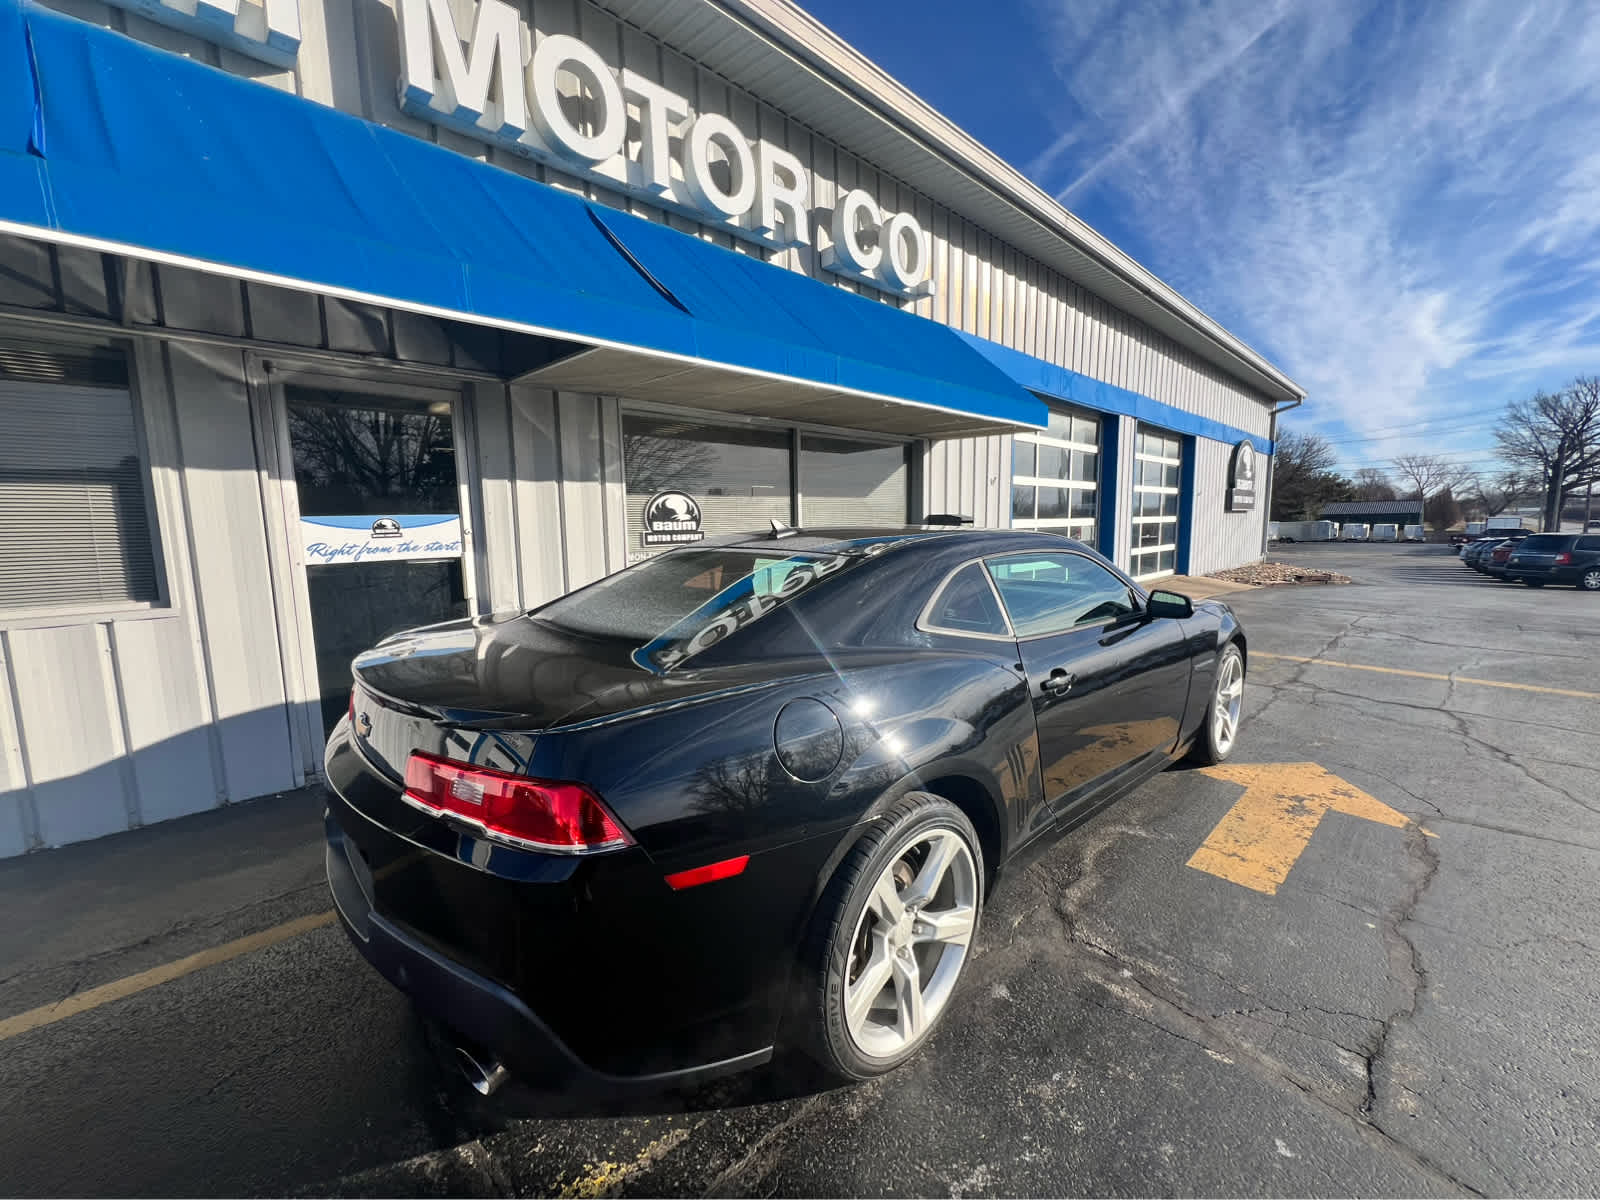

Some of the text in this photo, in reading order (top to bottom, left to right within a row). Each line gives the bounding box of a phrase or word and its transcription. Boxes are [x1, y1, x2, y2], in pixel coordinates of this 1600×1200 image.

[401, 0, 810, 246] MOTOR
[647, 533, 704, 542] MOTOR COMPANY
[307, 542, 358, 563] Right
[354, 541, 393, 561] from
[397, 540, 421, 553] the
